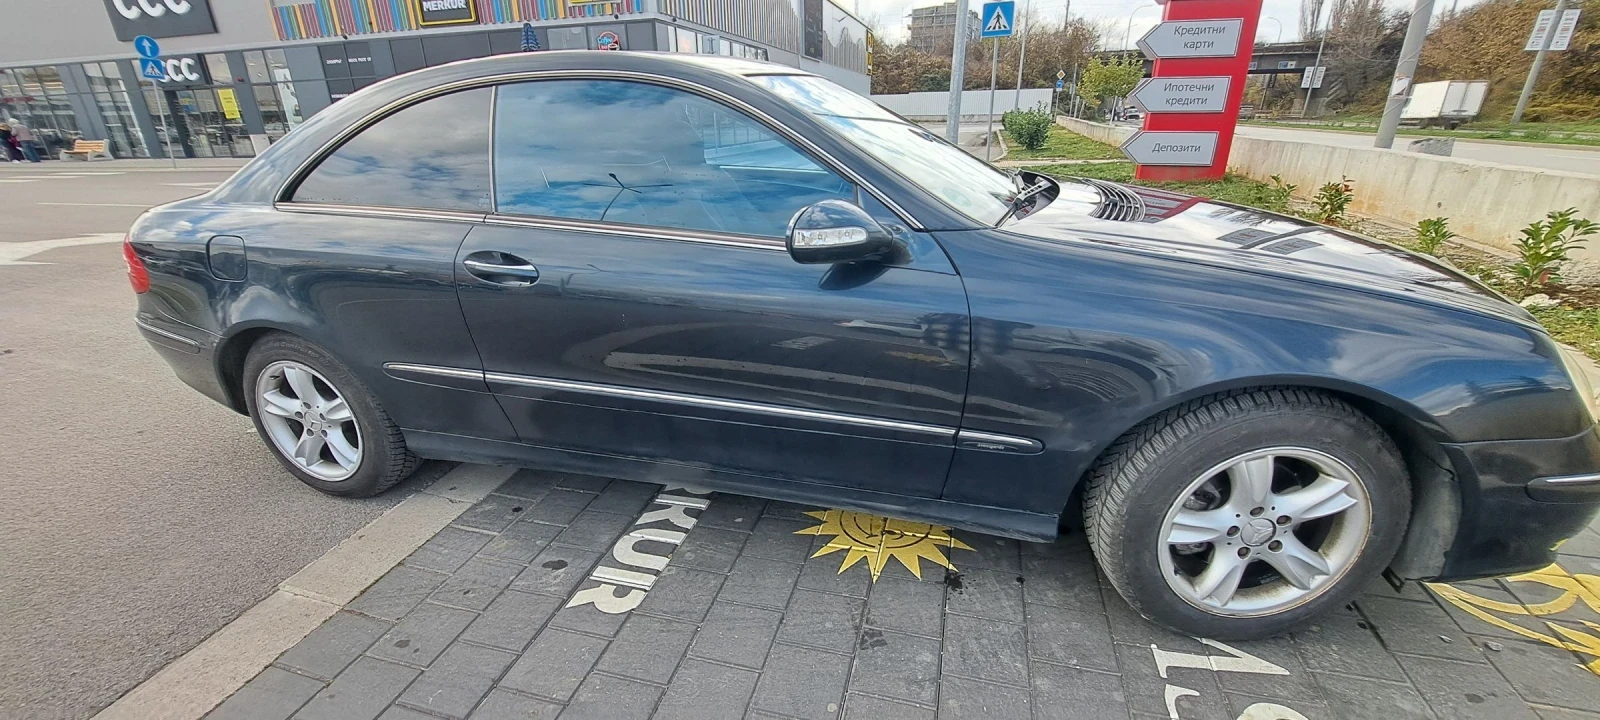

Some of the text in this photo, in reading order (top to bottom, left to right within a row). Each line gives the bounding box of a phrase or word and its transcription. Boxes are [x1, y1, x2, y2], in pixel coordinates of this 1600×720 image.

[423, 0, 468, 11] MERKUR
[1173, 25, 1226, 37] Кредитни
[1183, 40, 1214, 50] карти
[1163, 82, 1215, 92] Ипотечни
[1165, 97, 1208, 107] кредити
[1152, 143, 1201, 153] Депозити
